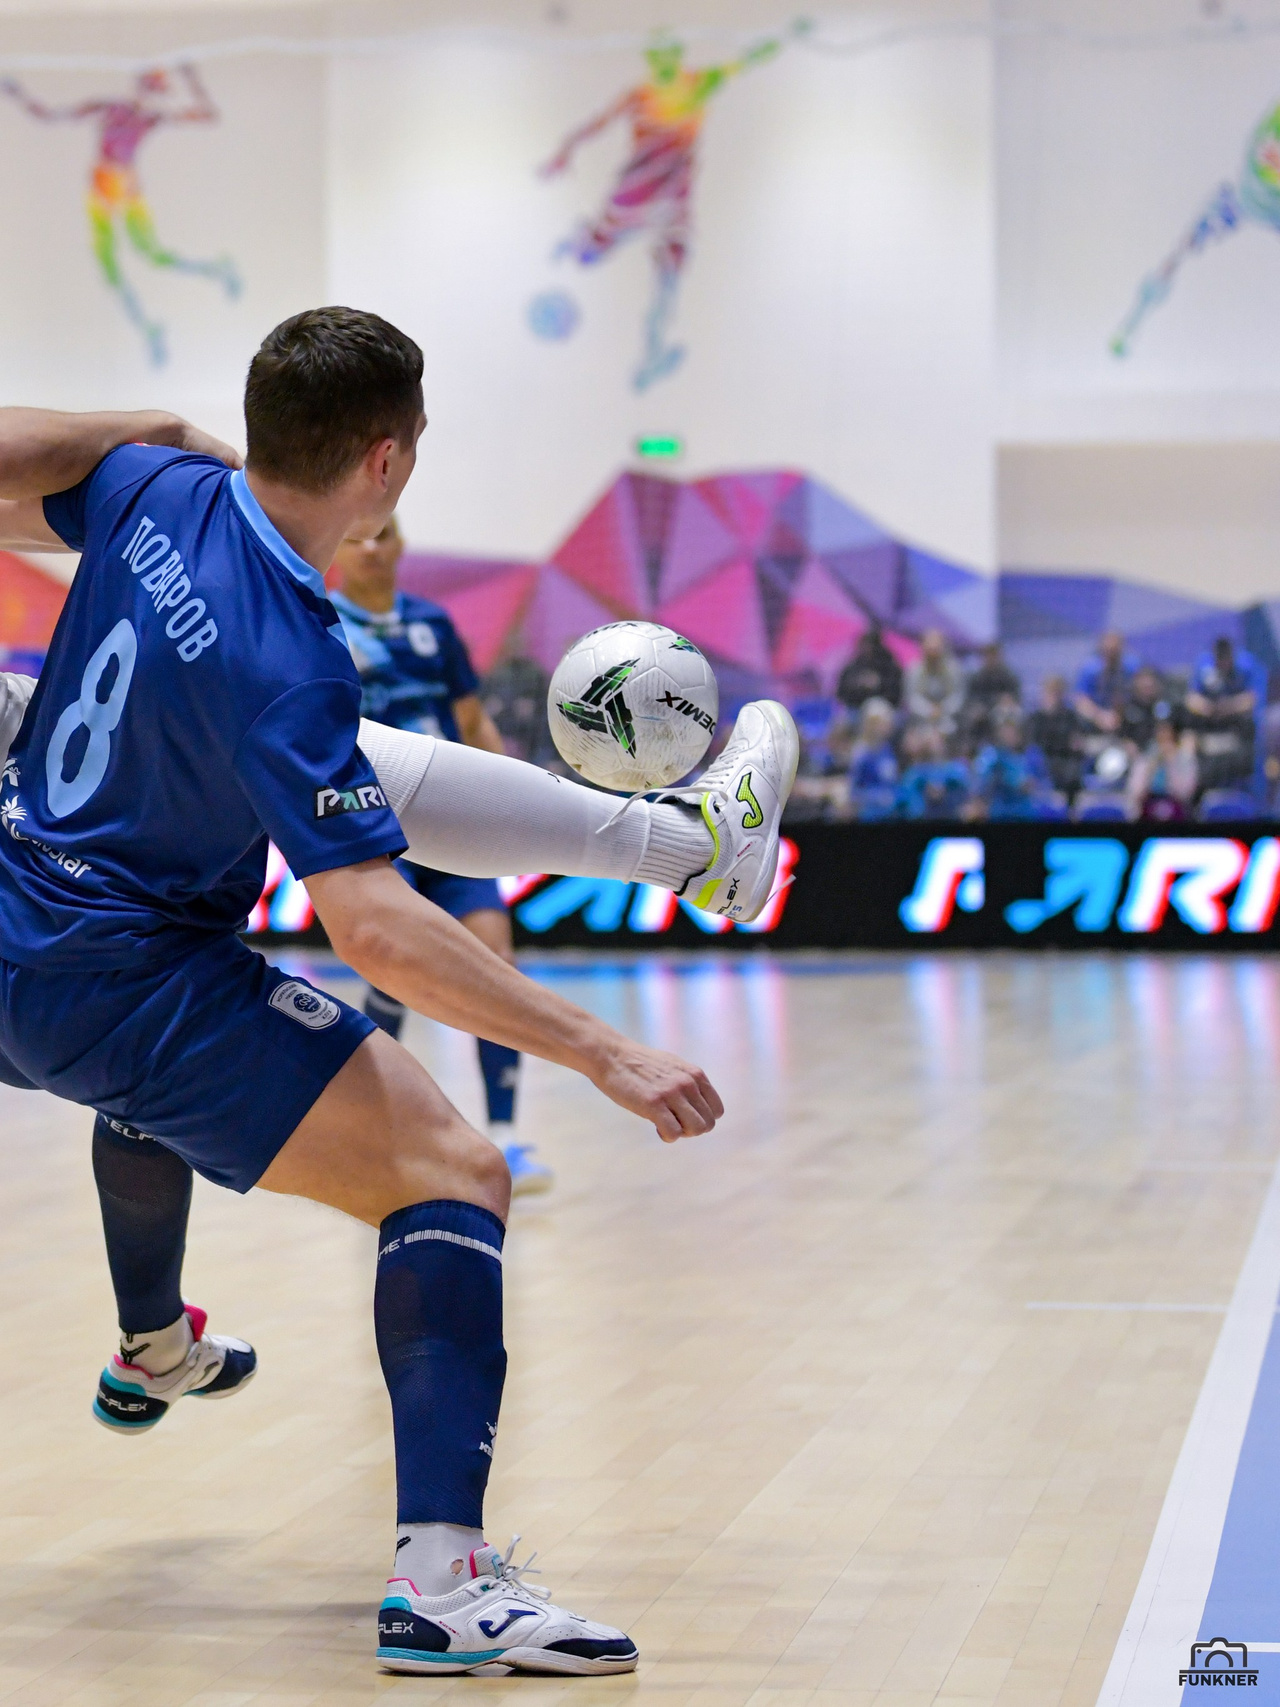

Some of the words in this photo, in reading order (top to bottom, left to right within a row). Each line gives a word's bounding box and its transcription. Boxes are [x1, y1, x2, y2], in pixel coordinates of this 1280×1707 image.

[120, 515, 219, 662] ПОВАРОВ
[46, 618, 138, 818] 8
[317, 786, 387, 817] PARI
